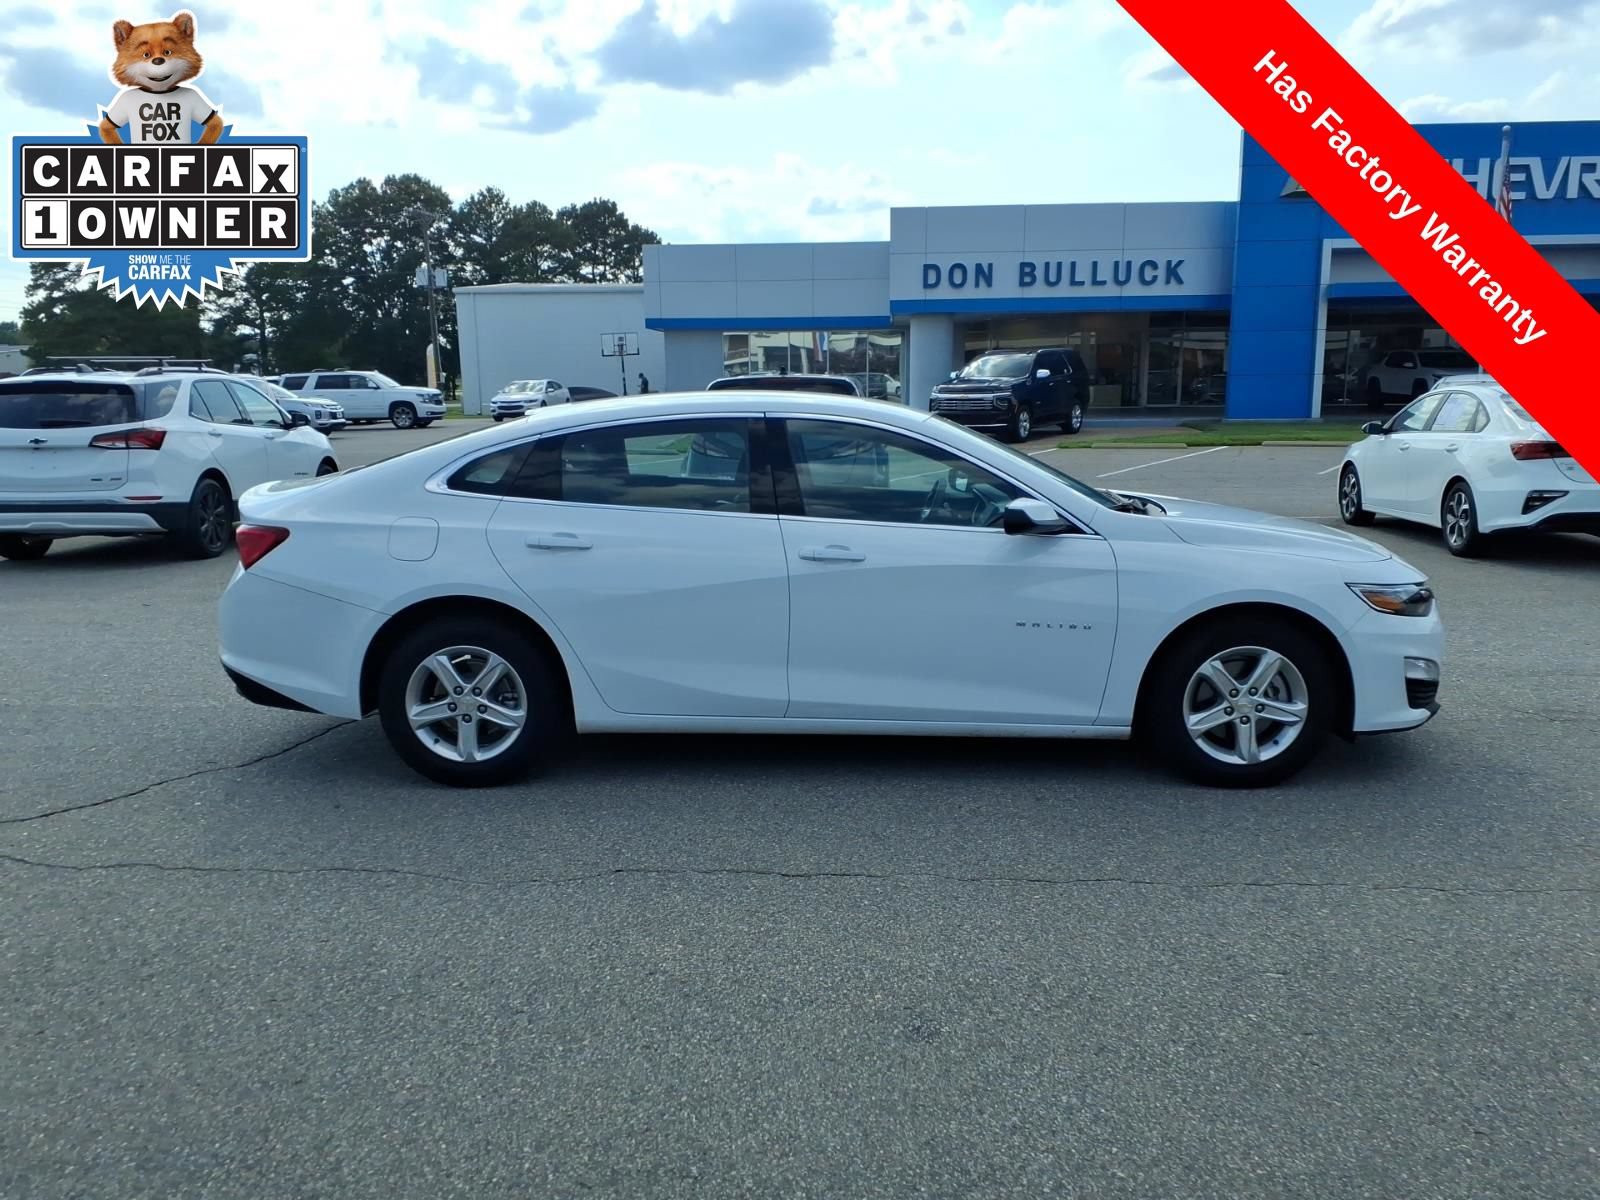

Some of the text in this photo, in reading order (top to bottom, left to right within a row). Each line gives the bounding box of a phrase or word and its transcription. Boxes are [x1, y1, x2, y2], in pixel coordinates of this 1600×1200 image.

[1445, 156, 1600, 200] HEVR
[922, 259, 1185, 290] DON BULLUCK
